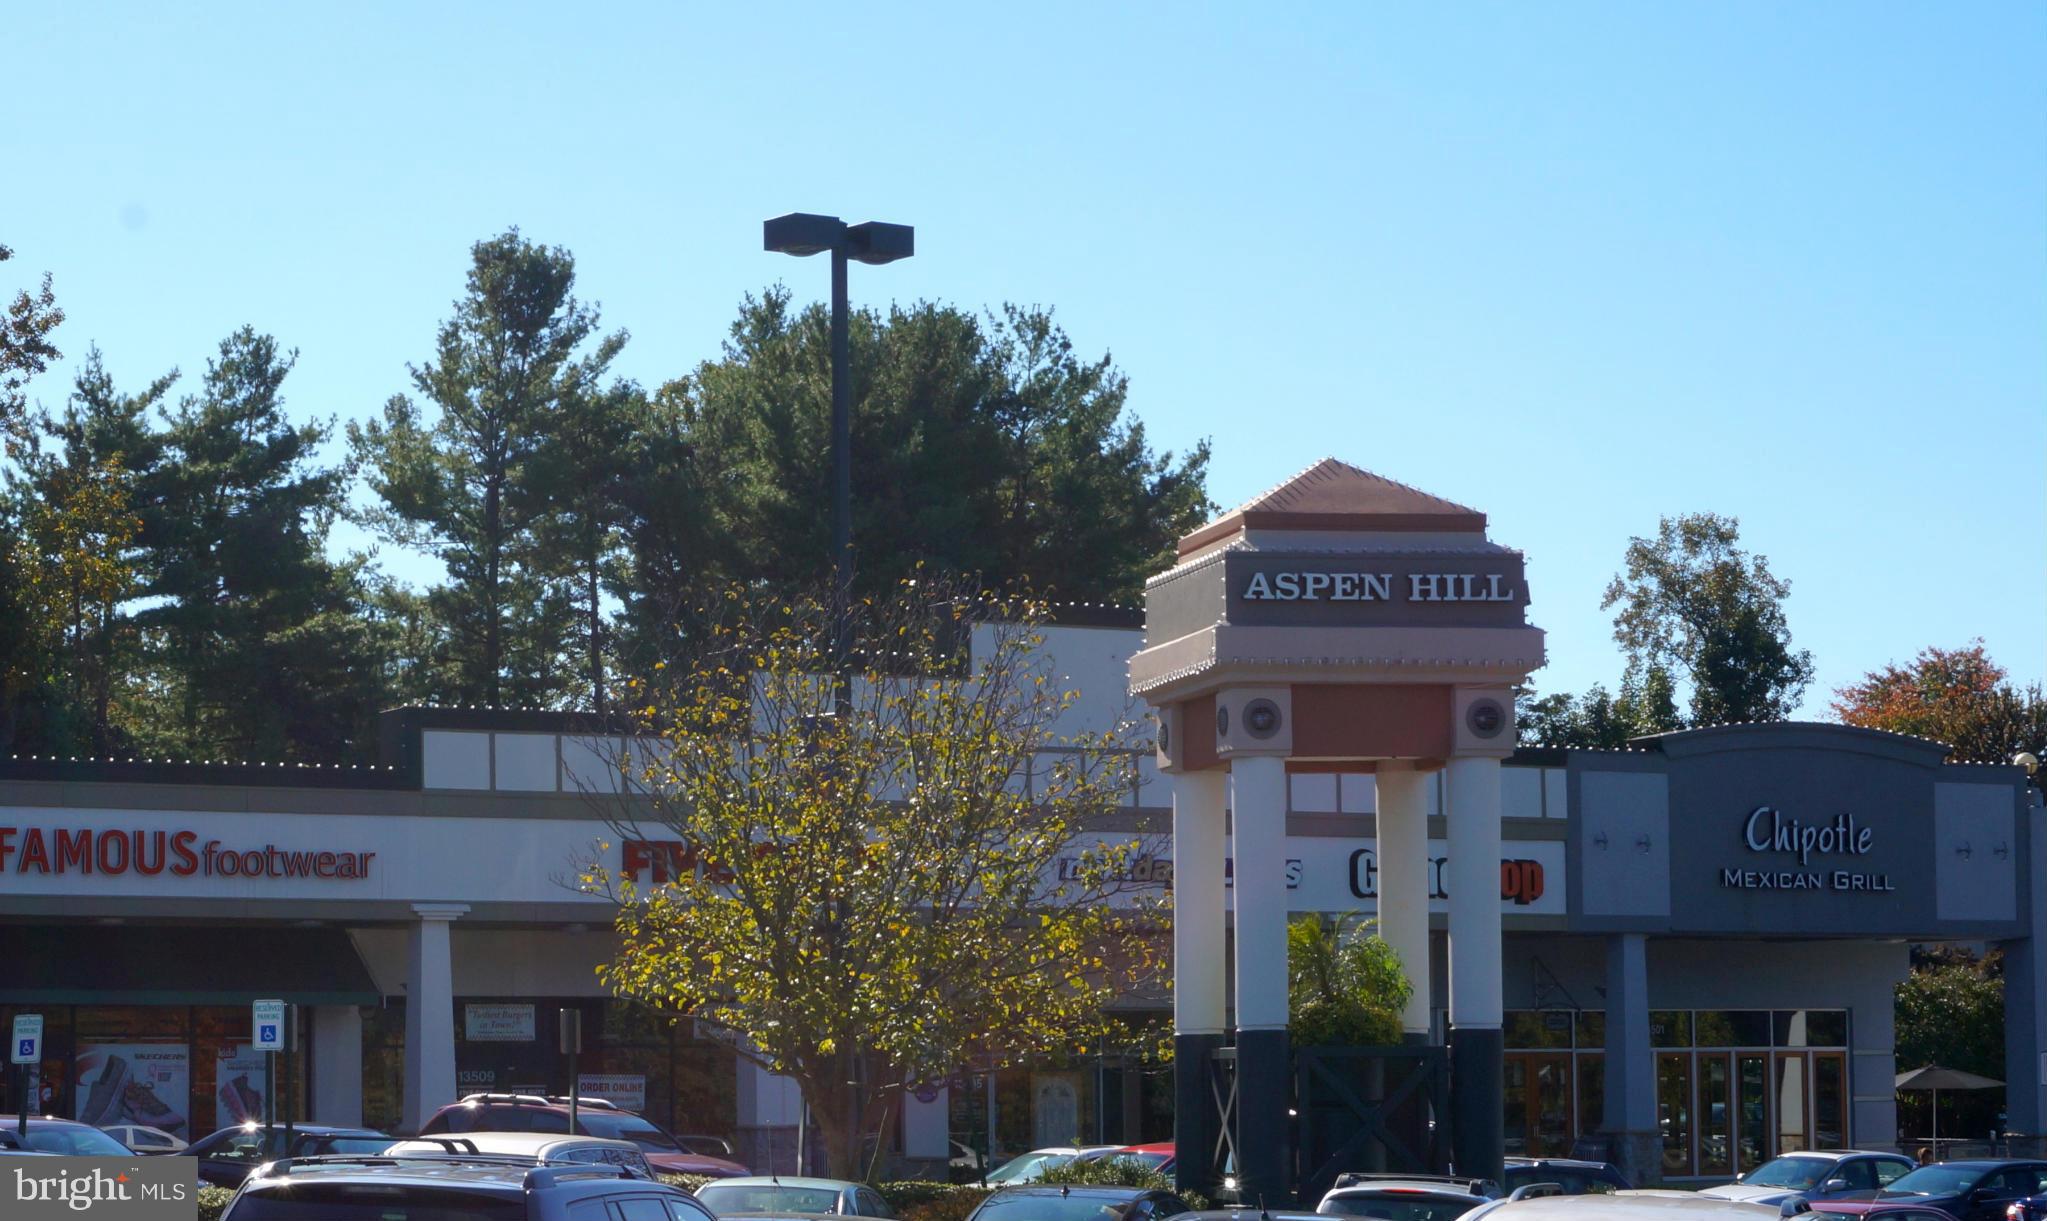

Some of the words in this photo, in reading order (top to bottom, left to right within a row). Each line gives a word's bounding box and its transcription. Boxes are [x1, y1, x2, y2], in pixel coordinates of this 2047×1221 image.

[1243, 572, 1392, 600] ASPEN
[1408, 574, 1513, 601] HILL
[1743, 806, 1873, 866] Chipotle
[0, 827, 199, 875] FAMOUS
[201, 840, 375, 879] footwear
[1721, 868, 1822, 889] MEXICAN
[1830, 870, 1895, 891] GRILL
[458, 1070, 496, 1083] 13509
[580, 1083, 609, 1093] ORDER
[612, 1083, 643, 1093] ONLINE
